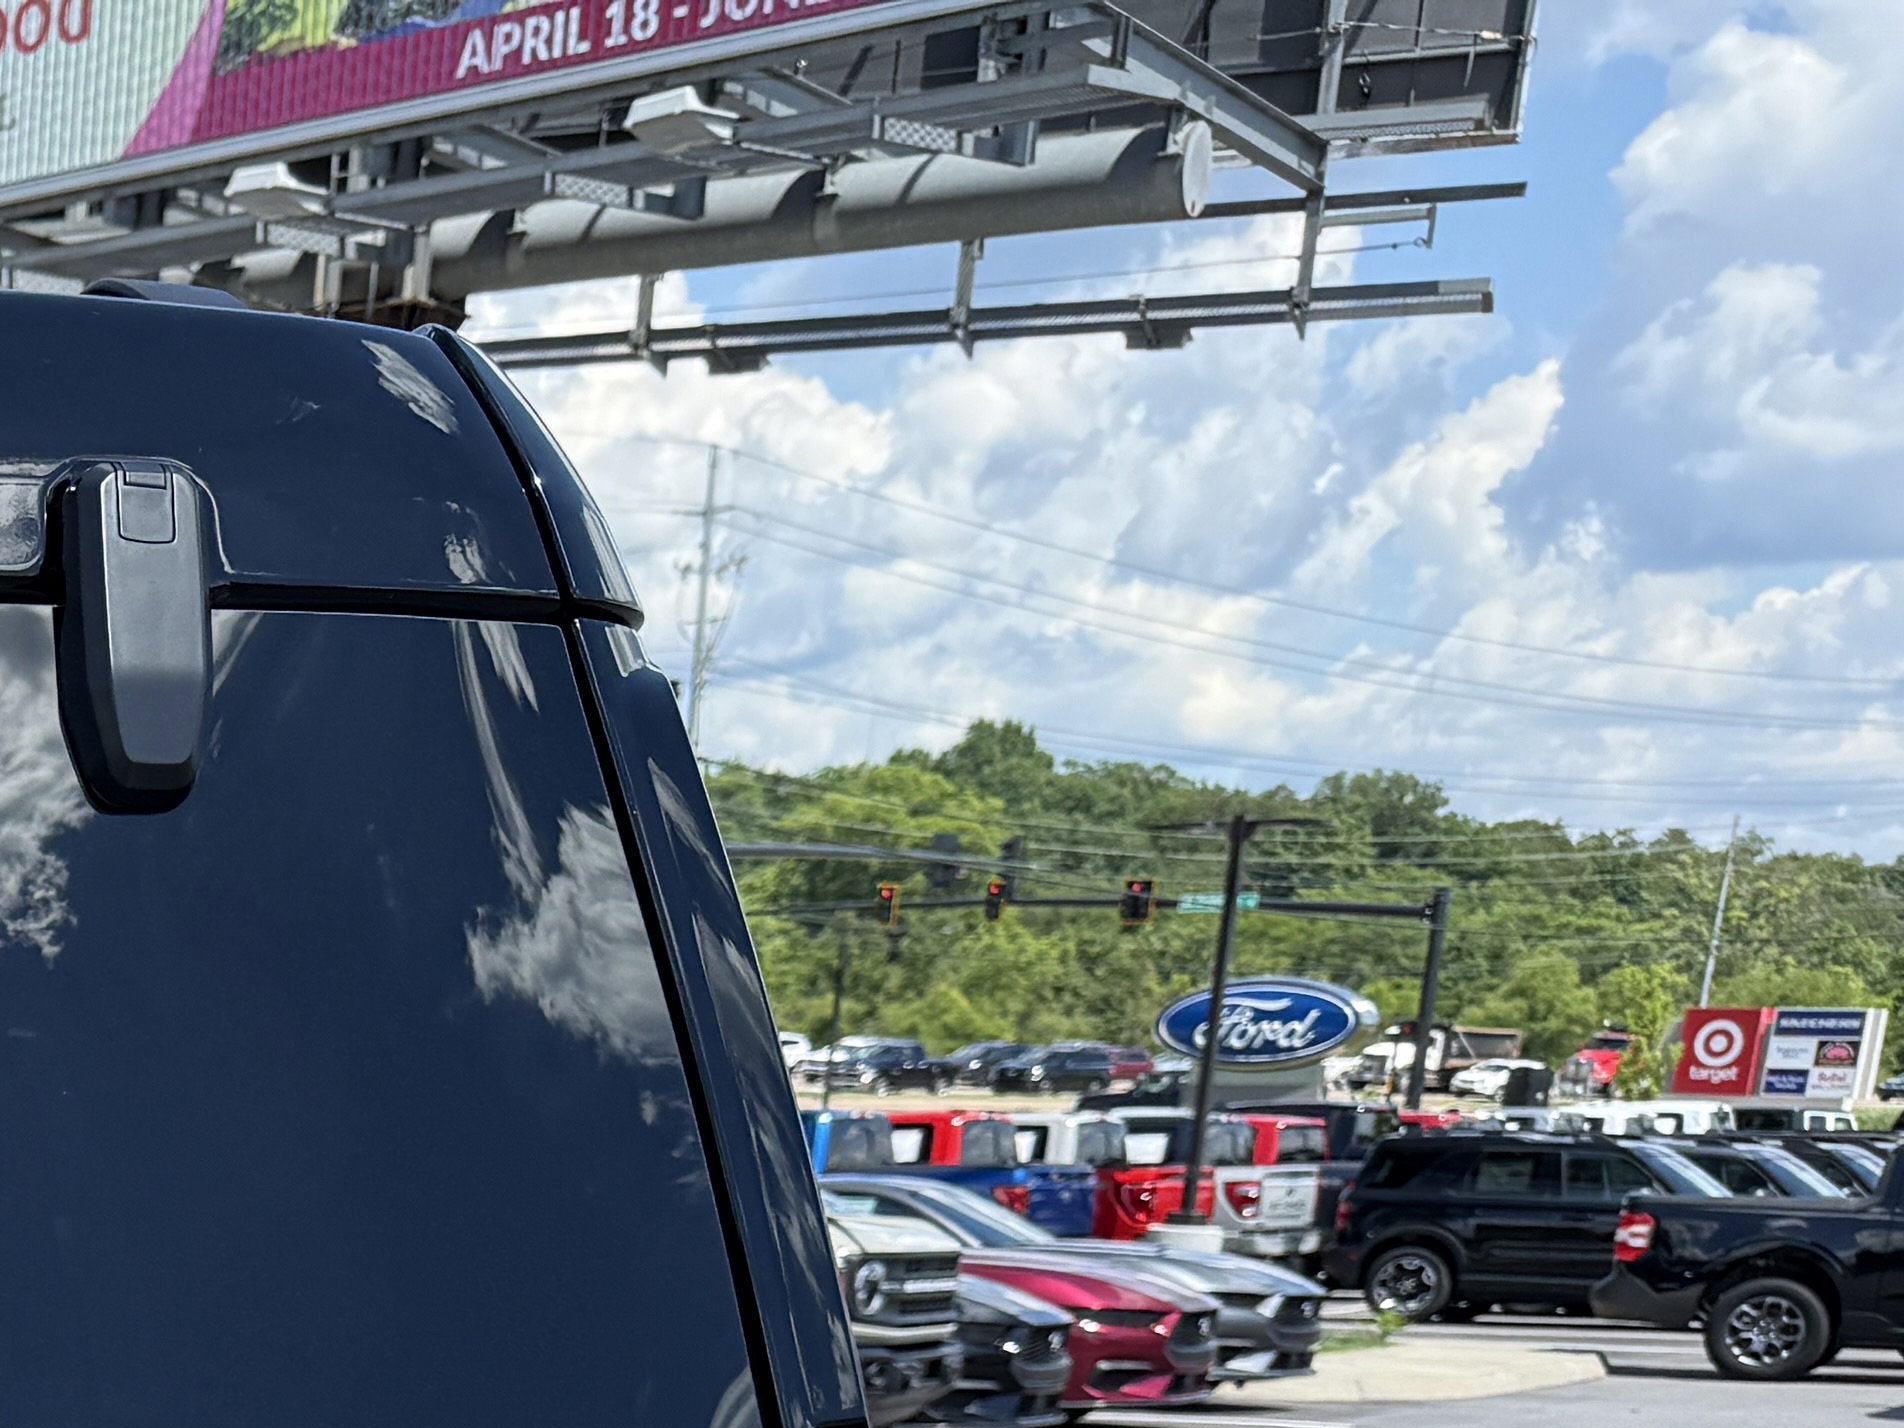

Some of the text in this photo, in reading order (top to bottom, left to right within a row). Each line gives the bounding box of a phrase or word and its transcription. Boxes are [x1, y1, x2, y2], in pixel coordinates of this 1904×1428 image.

[454, 6, 592, 80] APRIL
[603, 0, 660, 48] 18
[1192, 996, 1322, 1050] Ford
